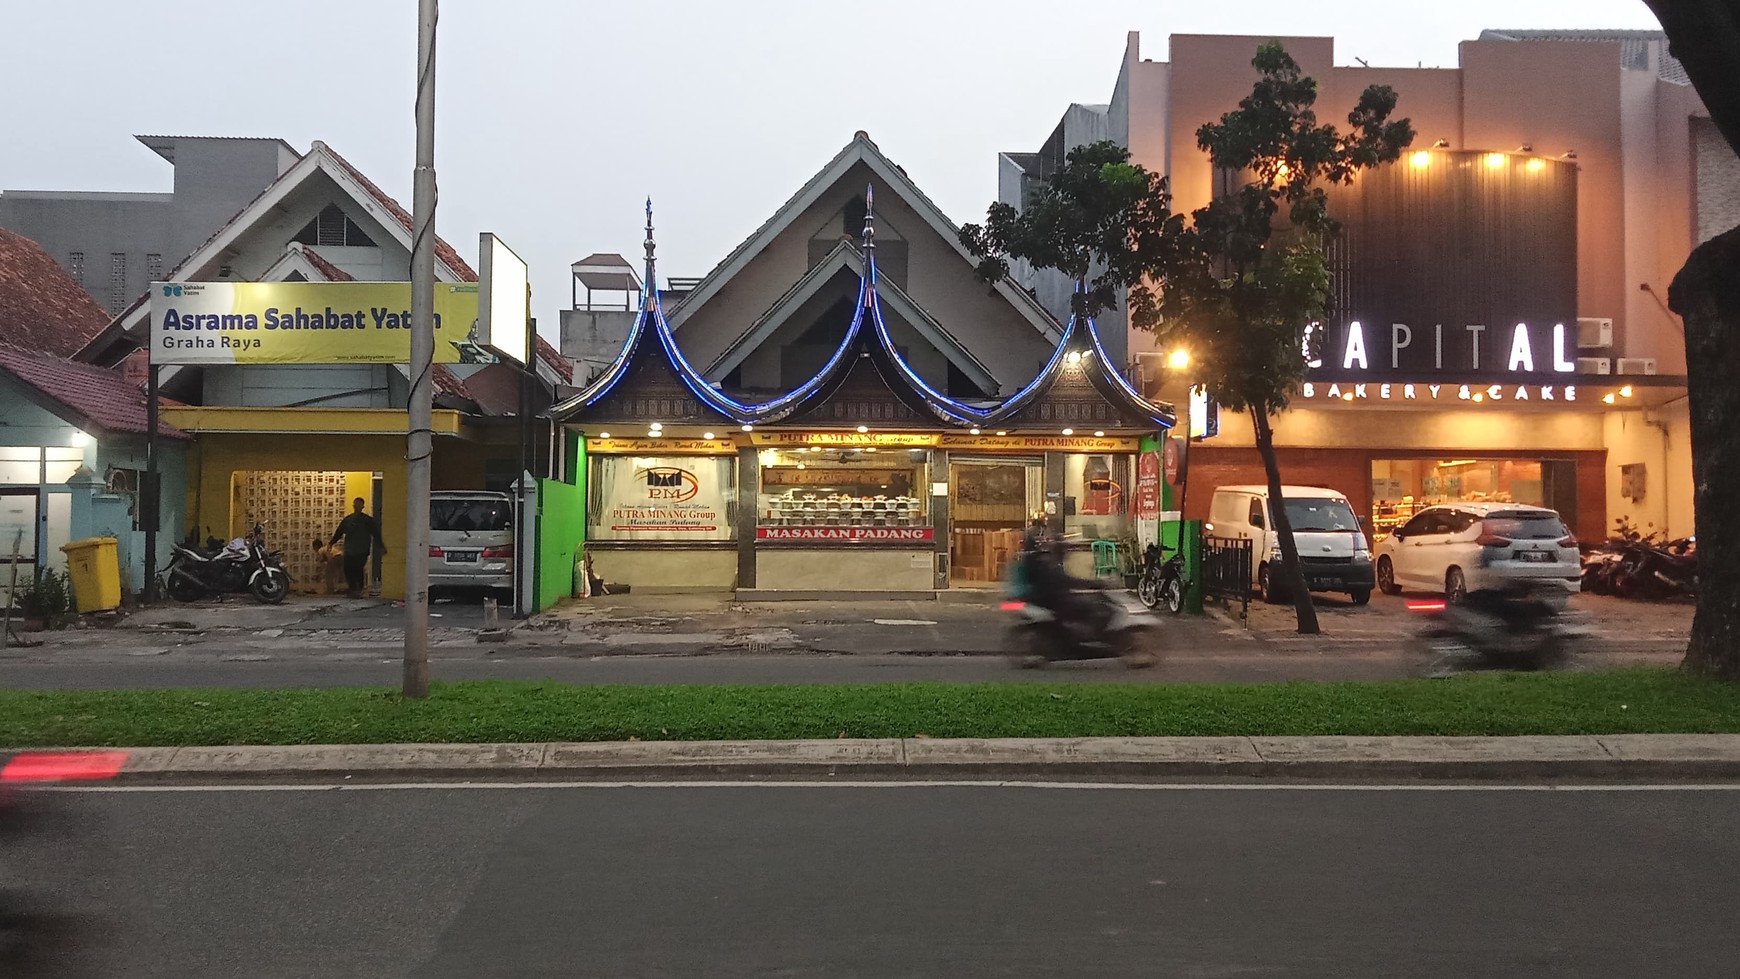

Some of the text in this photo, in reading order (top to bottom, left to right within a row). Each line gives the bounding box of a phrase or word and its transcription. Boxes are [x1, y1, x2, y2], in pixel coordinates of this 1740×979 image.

[162, 307, 442, 331] Asrama Sahabat Yat
[162, 336, 261, 351] Graha Raya
[1301, 320, 1575, 372] CAPITAL
[1303, 382, 1576, 401] BAKERY & CAKE
[779, 432, 823, 442] PUTRA
[1024, 438, 1055, 446] PUTRA
[1056, 438, 1094, 447] MINANG
[613, 509, 716, 520] PUTRA MINANG Group
[766, 529, 924, 539] MASAKAN PADANG
